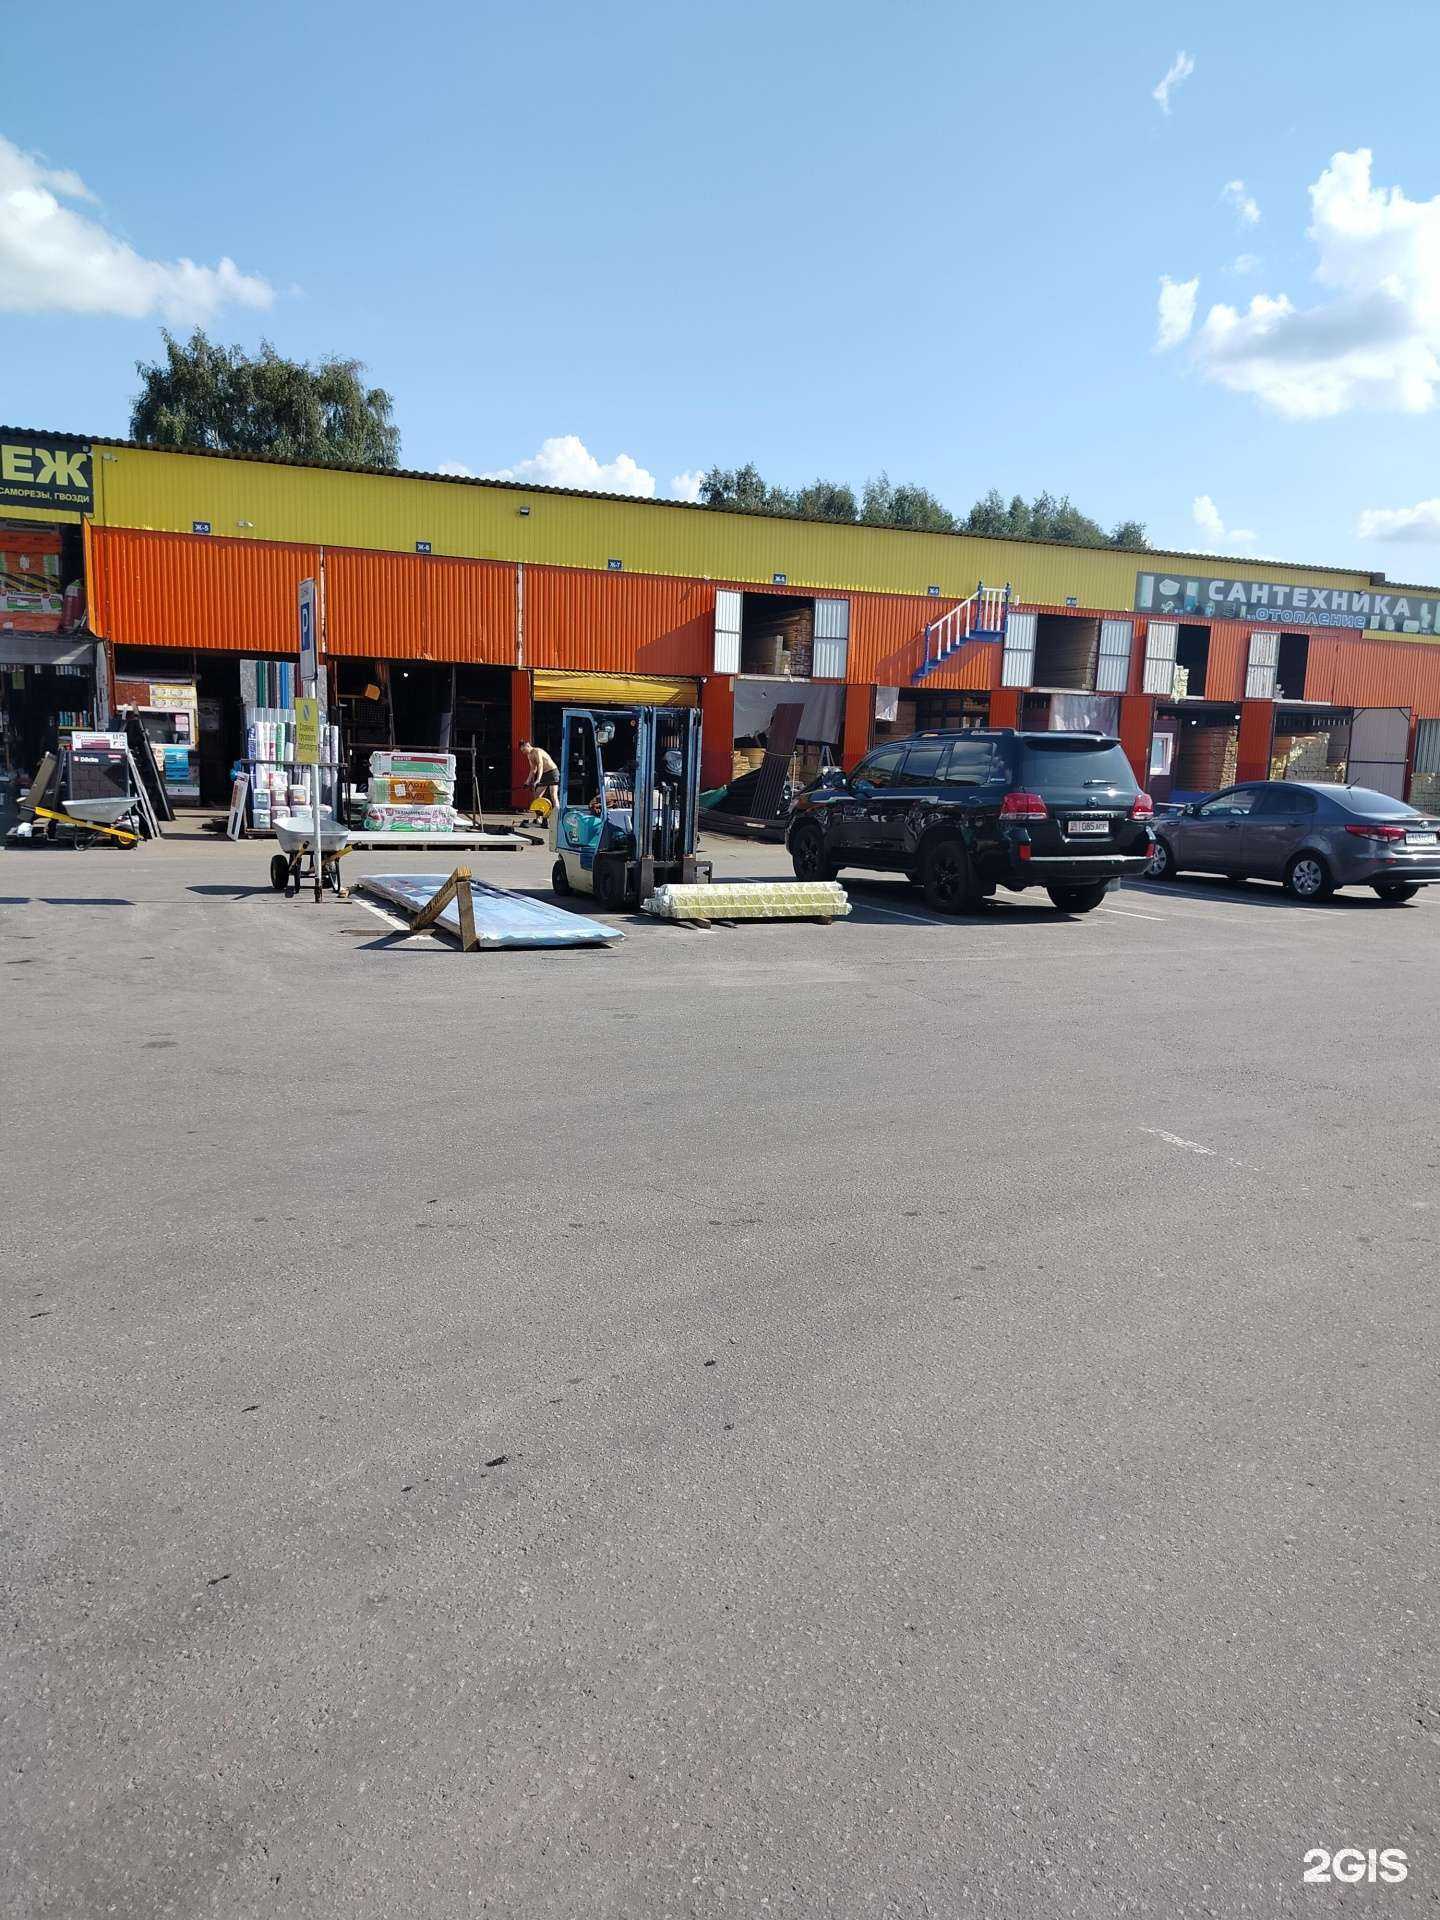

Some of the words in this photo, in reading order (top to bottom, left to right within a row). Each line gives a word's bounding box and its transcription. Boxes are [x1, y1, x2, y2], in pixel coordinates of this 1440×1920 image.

[1, 444, 89, 488] ЕЖ
[54, 492, 90, 503] ГВОЗДИ
[1208, 580, 1411, 617] САНТЕХНИКА
[302, 608, 308, 649] P
